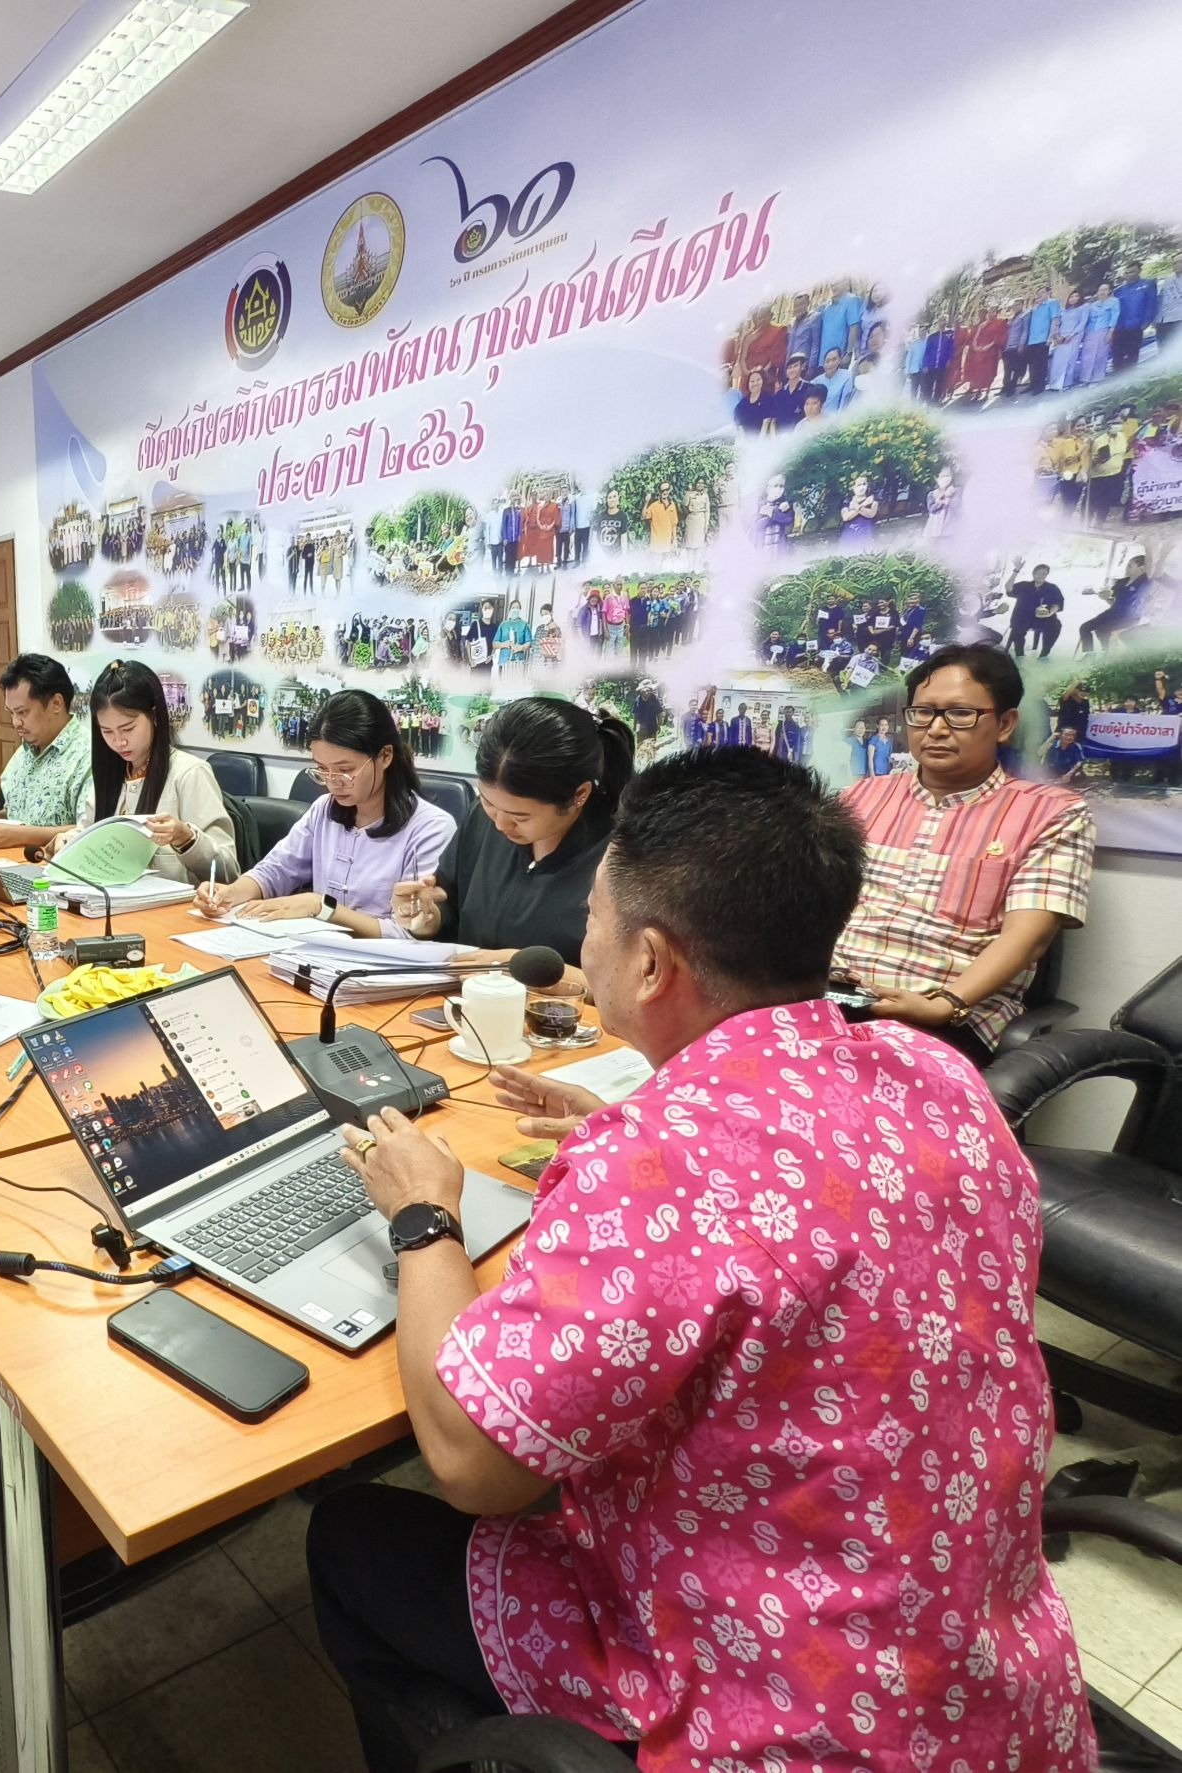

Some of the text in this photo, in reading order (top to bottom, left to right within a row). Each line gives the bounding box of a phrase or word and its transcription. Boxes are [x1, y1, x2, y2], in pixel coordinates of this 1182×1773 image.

[472, 232, 568, 278] กรมการพัฒนาชุมชน
[137, 190, 783, 482] เชิดชูเกียรติกิจกรรมพัฒนาชุมชนดีเด่น
[258, 400, 485, 506] ประจำปี ๒๕๖๖
[423, 1083, 445, 1096] NPE
